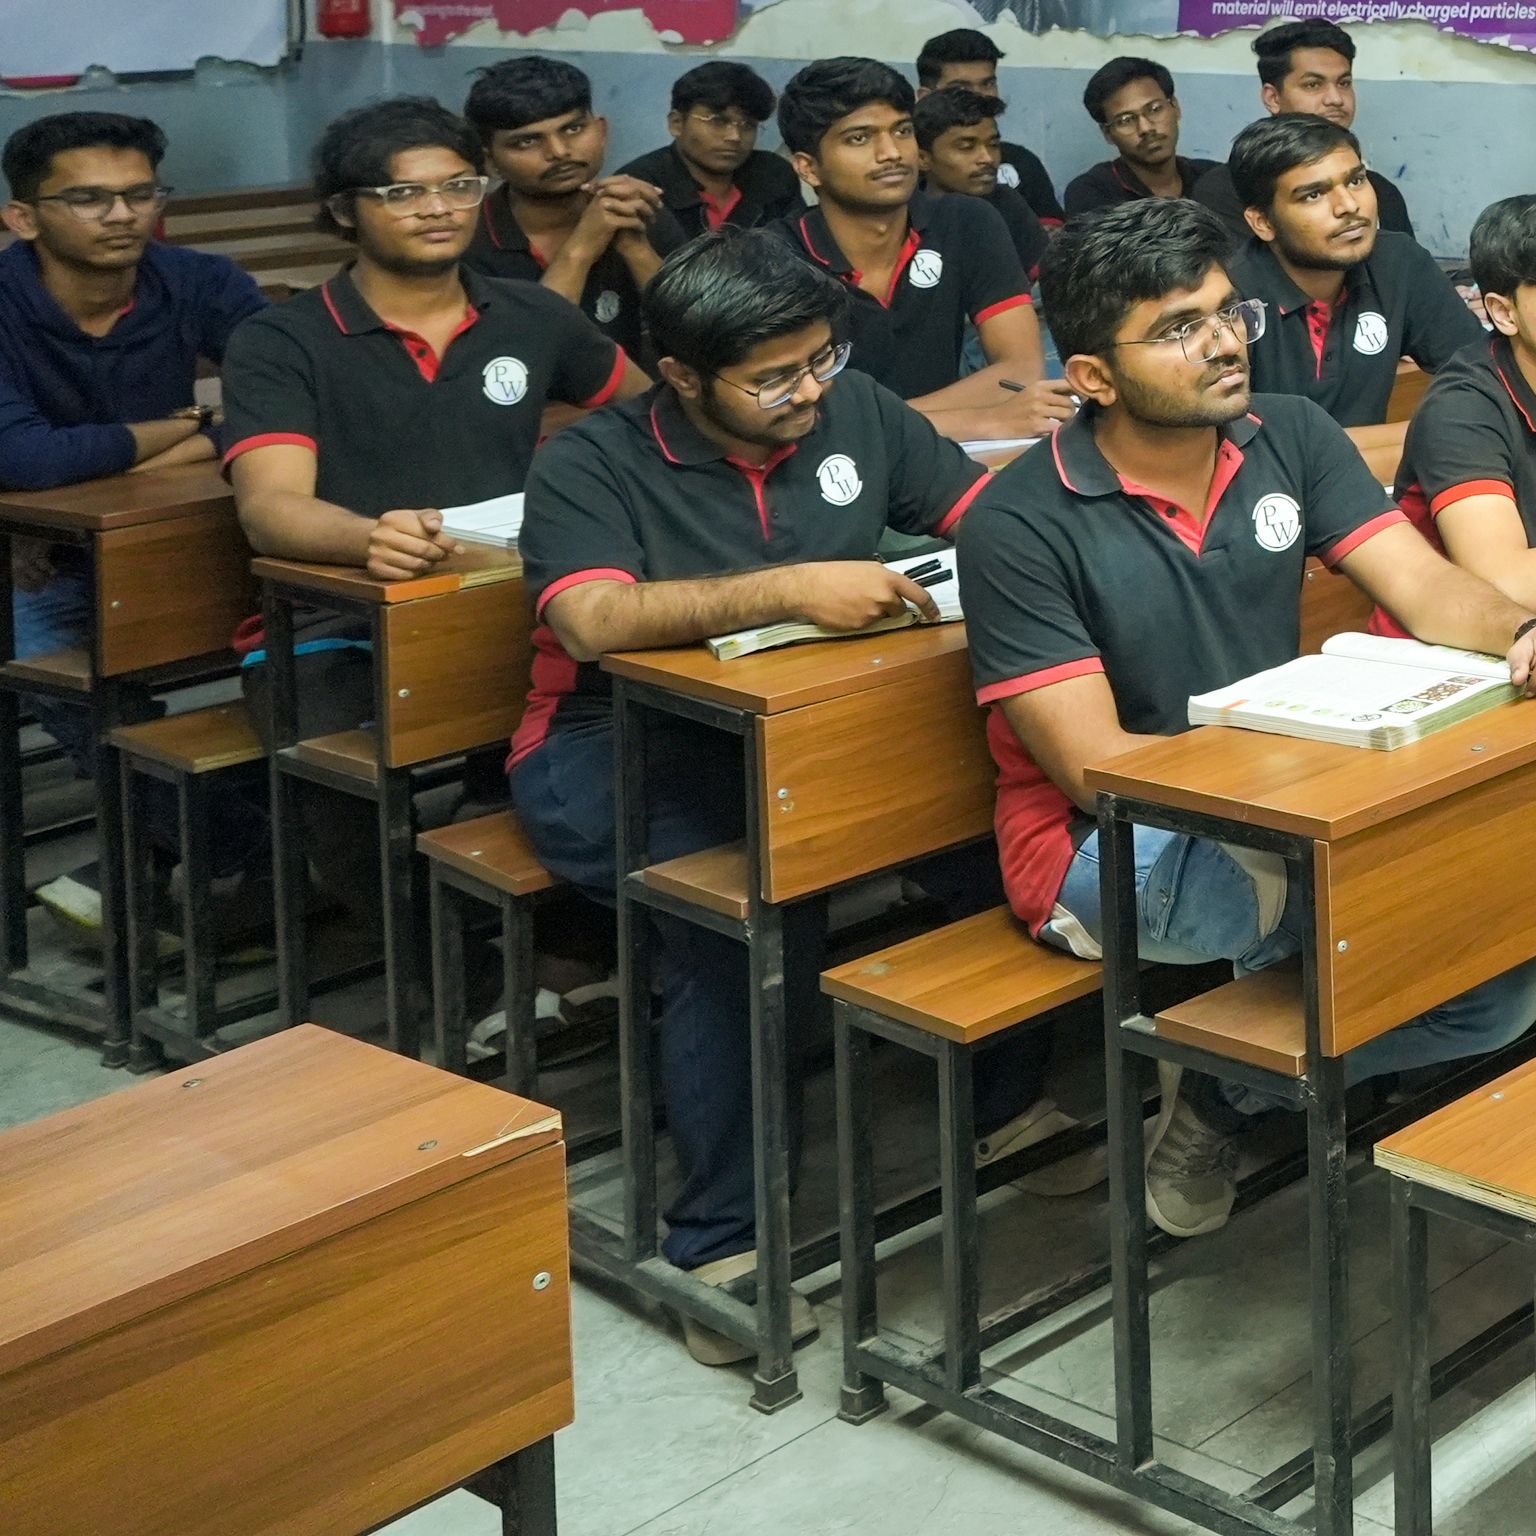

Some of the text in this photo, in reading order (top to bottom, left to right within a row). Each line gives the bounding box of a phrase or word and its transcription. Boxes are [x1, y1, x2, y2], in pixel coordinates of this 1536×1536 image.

[1212, 0, 1270, 15] material
[1271, 0, 1295, 15] will
[1295, 0, 1327, 16] emit
[1330, 0, 1406, 19] electrically
[1406, 2, 1470, 23] charged
[1470, 2, 1536, 24] particles
